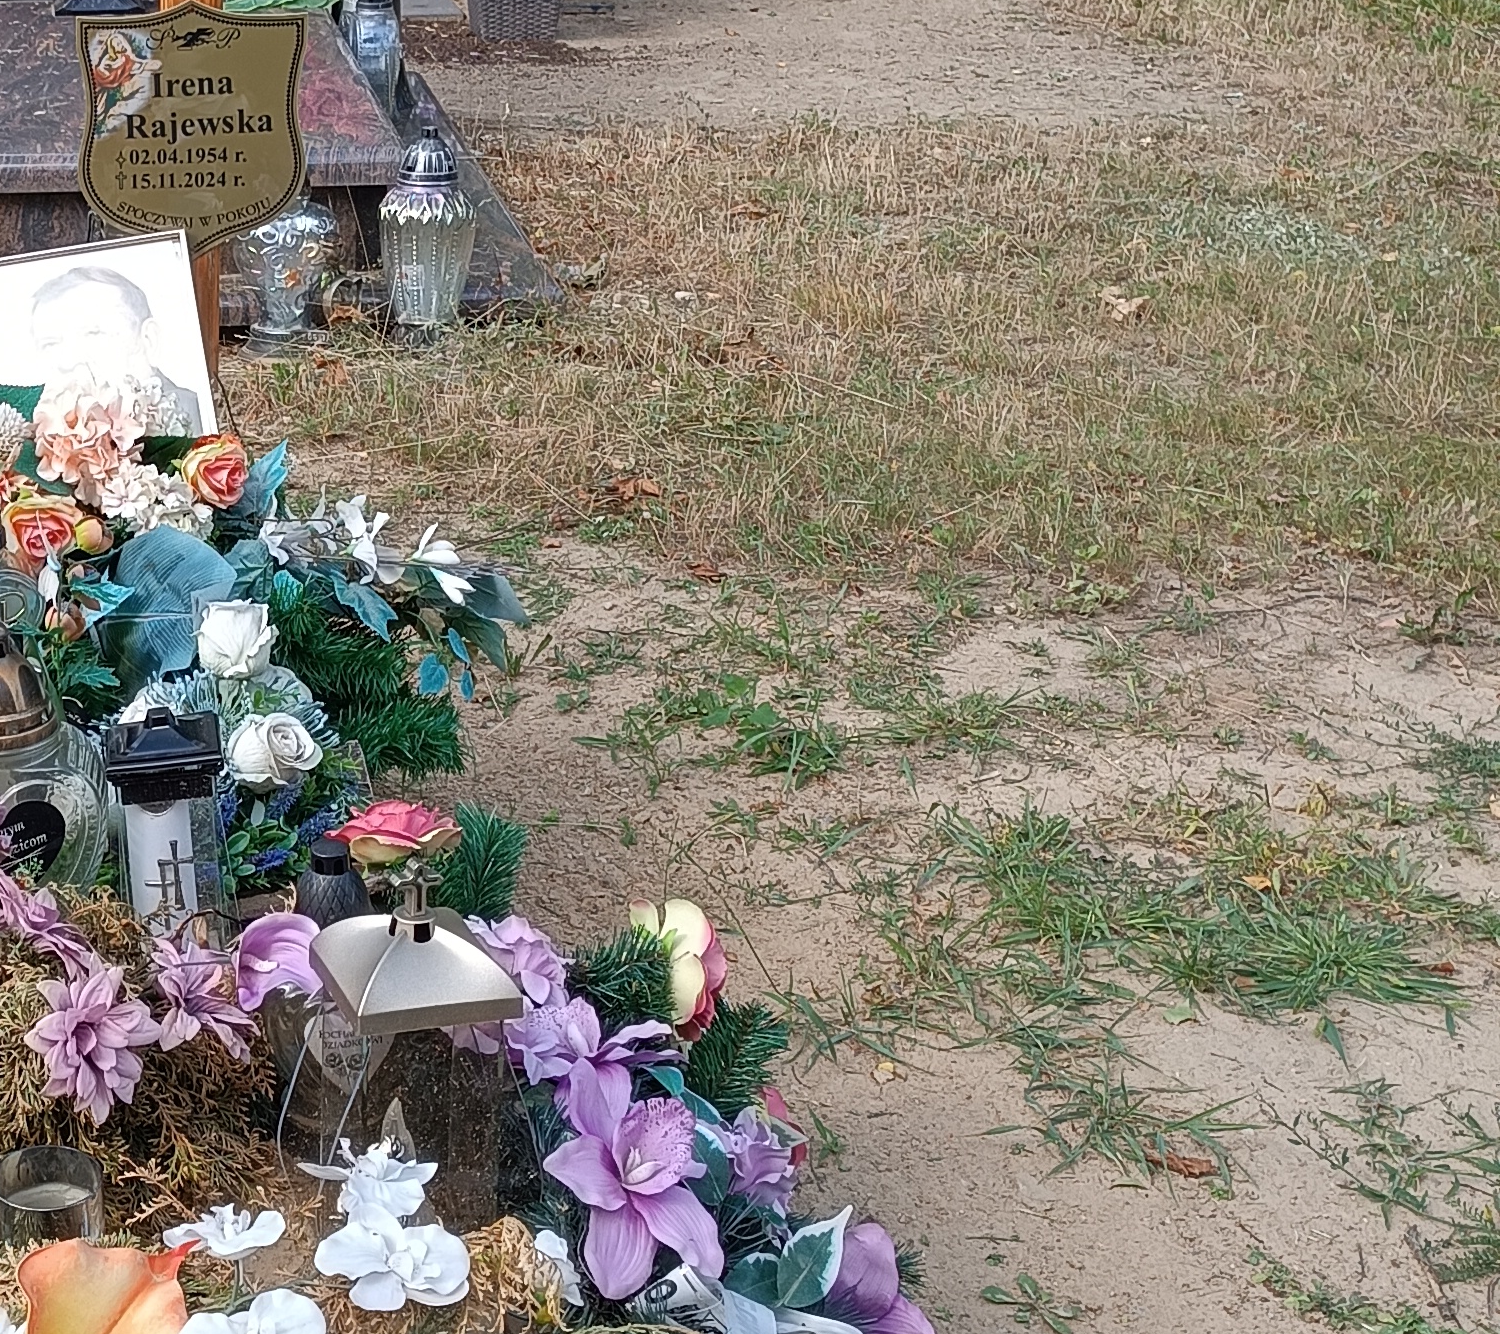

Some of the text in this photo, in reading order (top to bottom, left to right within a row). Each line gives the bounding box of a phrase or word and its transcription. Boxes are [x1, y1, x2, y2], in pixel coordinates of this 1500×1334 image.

[152, 72, 234, 99] Irena
[125, 109, 273, 145] Rajewska
[129, 147, 248, 165] 02.04.1954 r.
[131, 171, 246, 189] 15.11.2024 r.
[117, 196, 272, 229] SPOCZYWAJ W POKOJU
